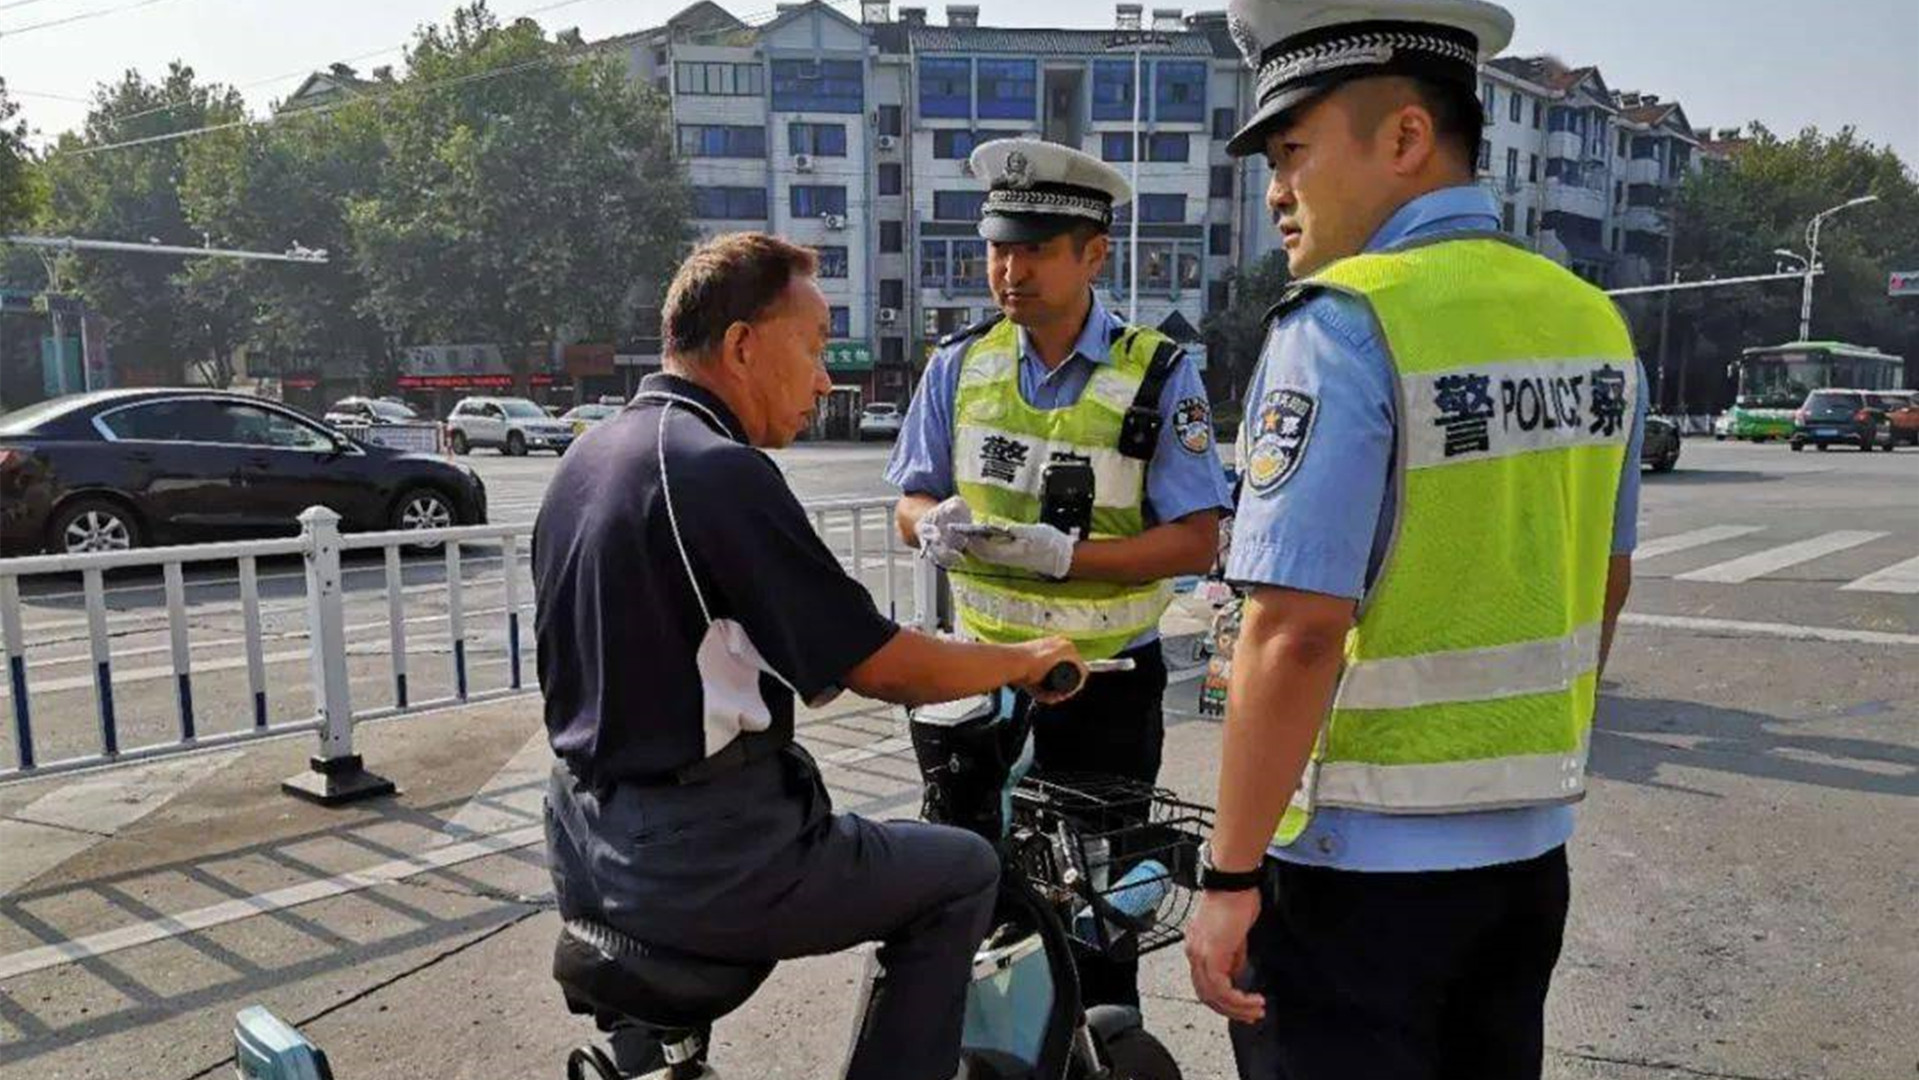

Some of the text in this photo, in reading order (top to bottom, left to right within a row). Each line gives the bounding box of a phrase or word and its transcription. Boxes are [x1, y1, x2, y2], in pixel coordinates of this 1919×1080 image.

[1434, 373, 1494, 457] 警
[1501, 375, 1584, 433] POLICE
[1589, 363, 1626, 437] 察
[979, 435, 1030, 483] 警
